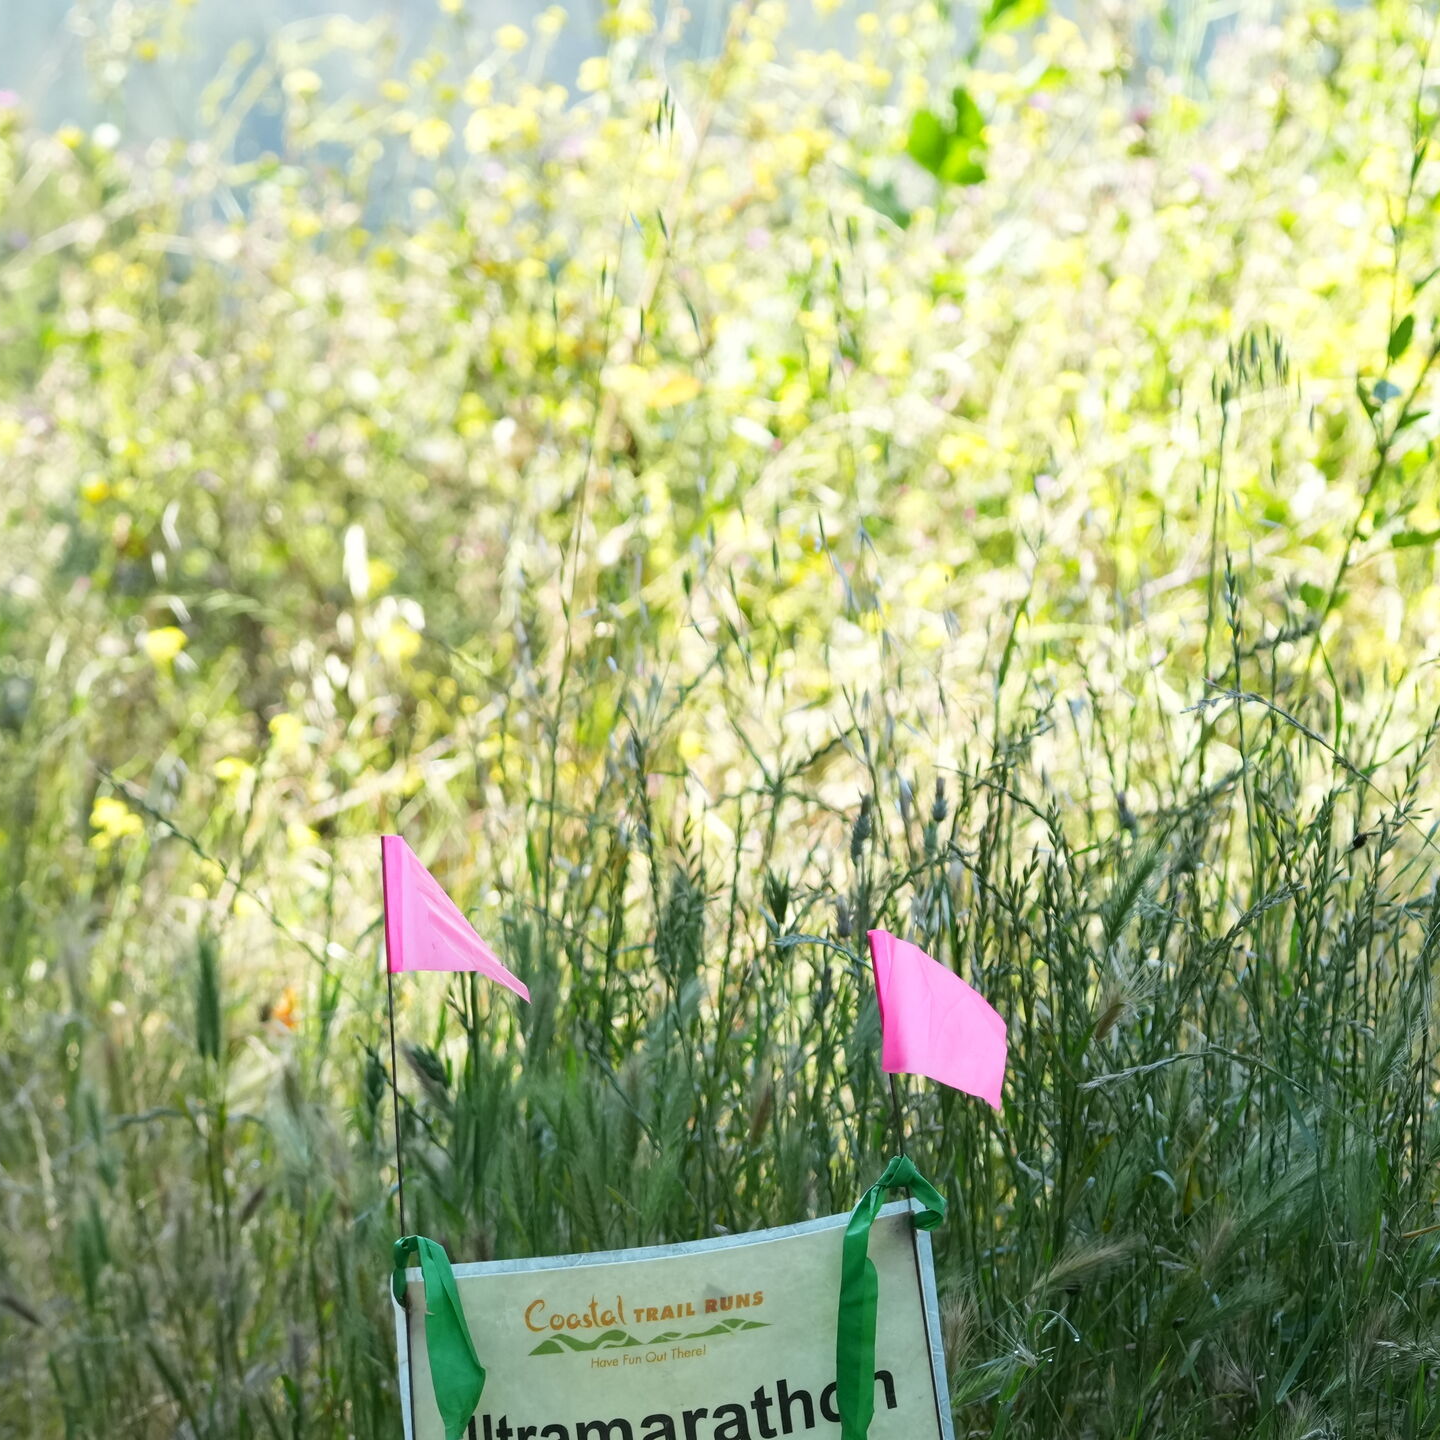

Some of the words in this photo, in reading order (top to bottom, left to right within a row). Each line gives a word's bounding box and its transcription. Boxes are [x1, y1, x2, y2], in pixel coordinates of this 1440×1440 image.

[524, 1294, 627, 1332] Coastal
[634, 1303, 695, 1323] TRAIL
[705, 1291, 764, 1314] RUNS
[591, 1354, 619, 1369] Have
[622, 1353, 642, 1366] Fun
[671, 1344, 707, 1360] There!
